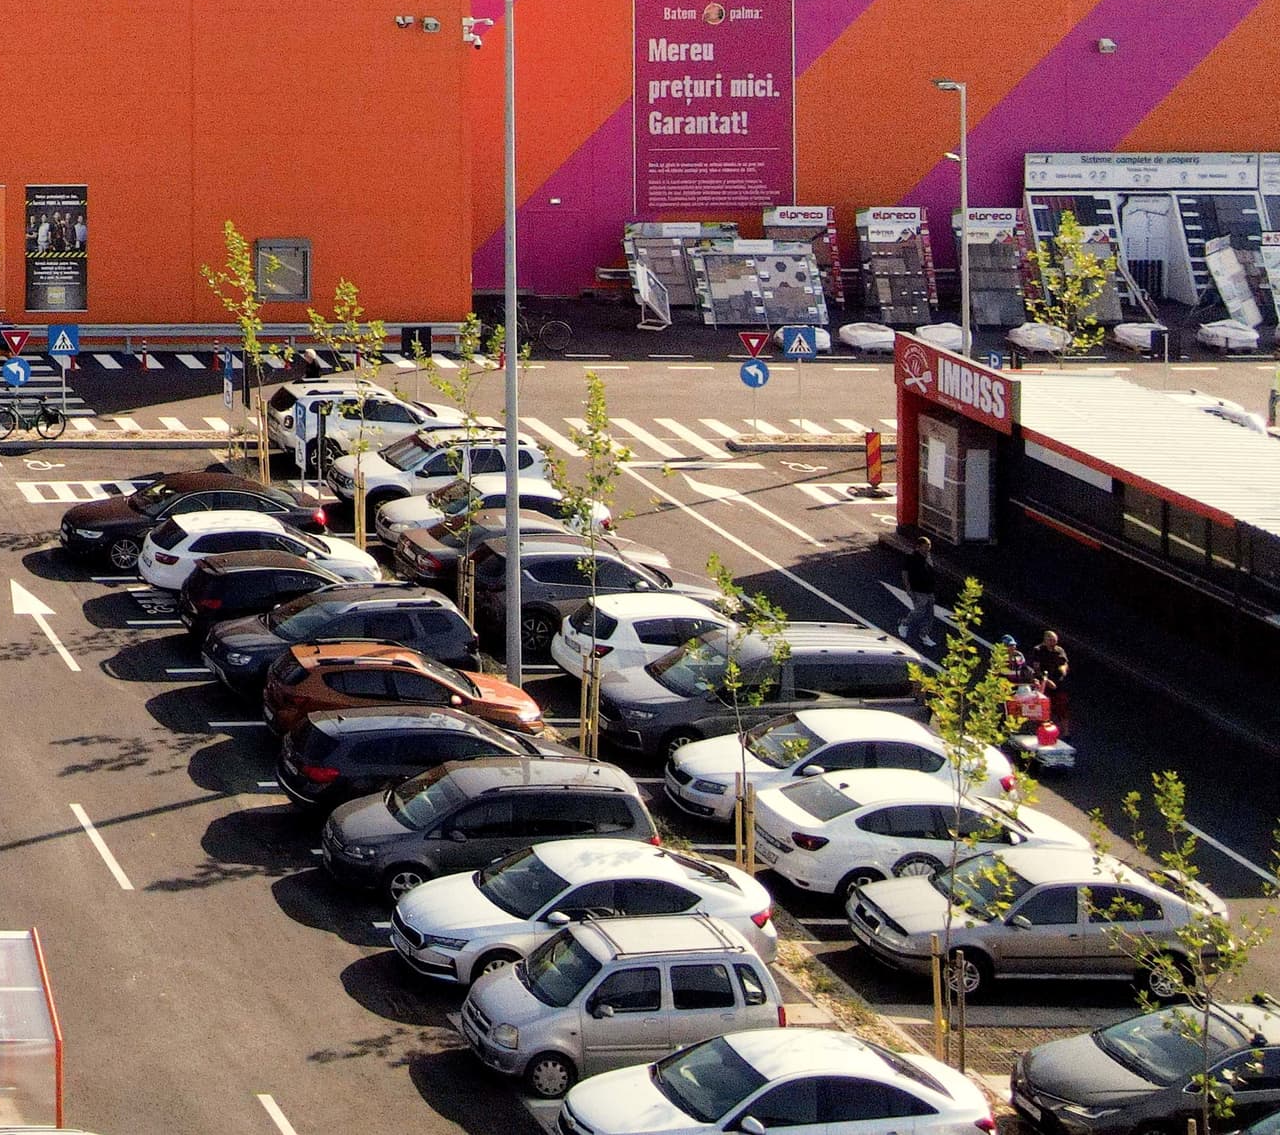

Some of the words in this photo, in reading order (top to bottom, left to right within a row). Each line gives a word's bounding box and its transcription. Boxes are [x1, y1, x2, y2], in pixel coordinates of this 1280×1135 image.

[663, 7, 696, 20] Batem
[729, 7, 763, 21] palma:
[648, 38, 714, 62] Mereu
[648, 73, 723, 106] prețuri
[730, 73, 780, 98] mici.
[648, 111, 749, 135] Garantat!
[1080, 155, 1112, 164] Sisteme
[1115, 155, 1152, 166] complete
[1153, 155, 1164, 164] de
[779, 210, 823, 220] elpreco
[872, 210, 916, 221] elpreco
[969, 211, 1013, 221] elpreco
[990, 354, 999, 366] P
[938, 357, 1005, 419] IMBISS
